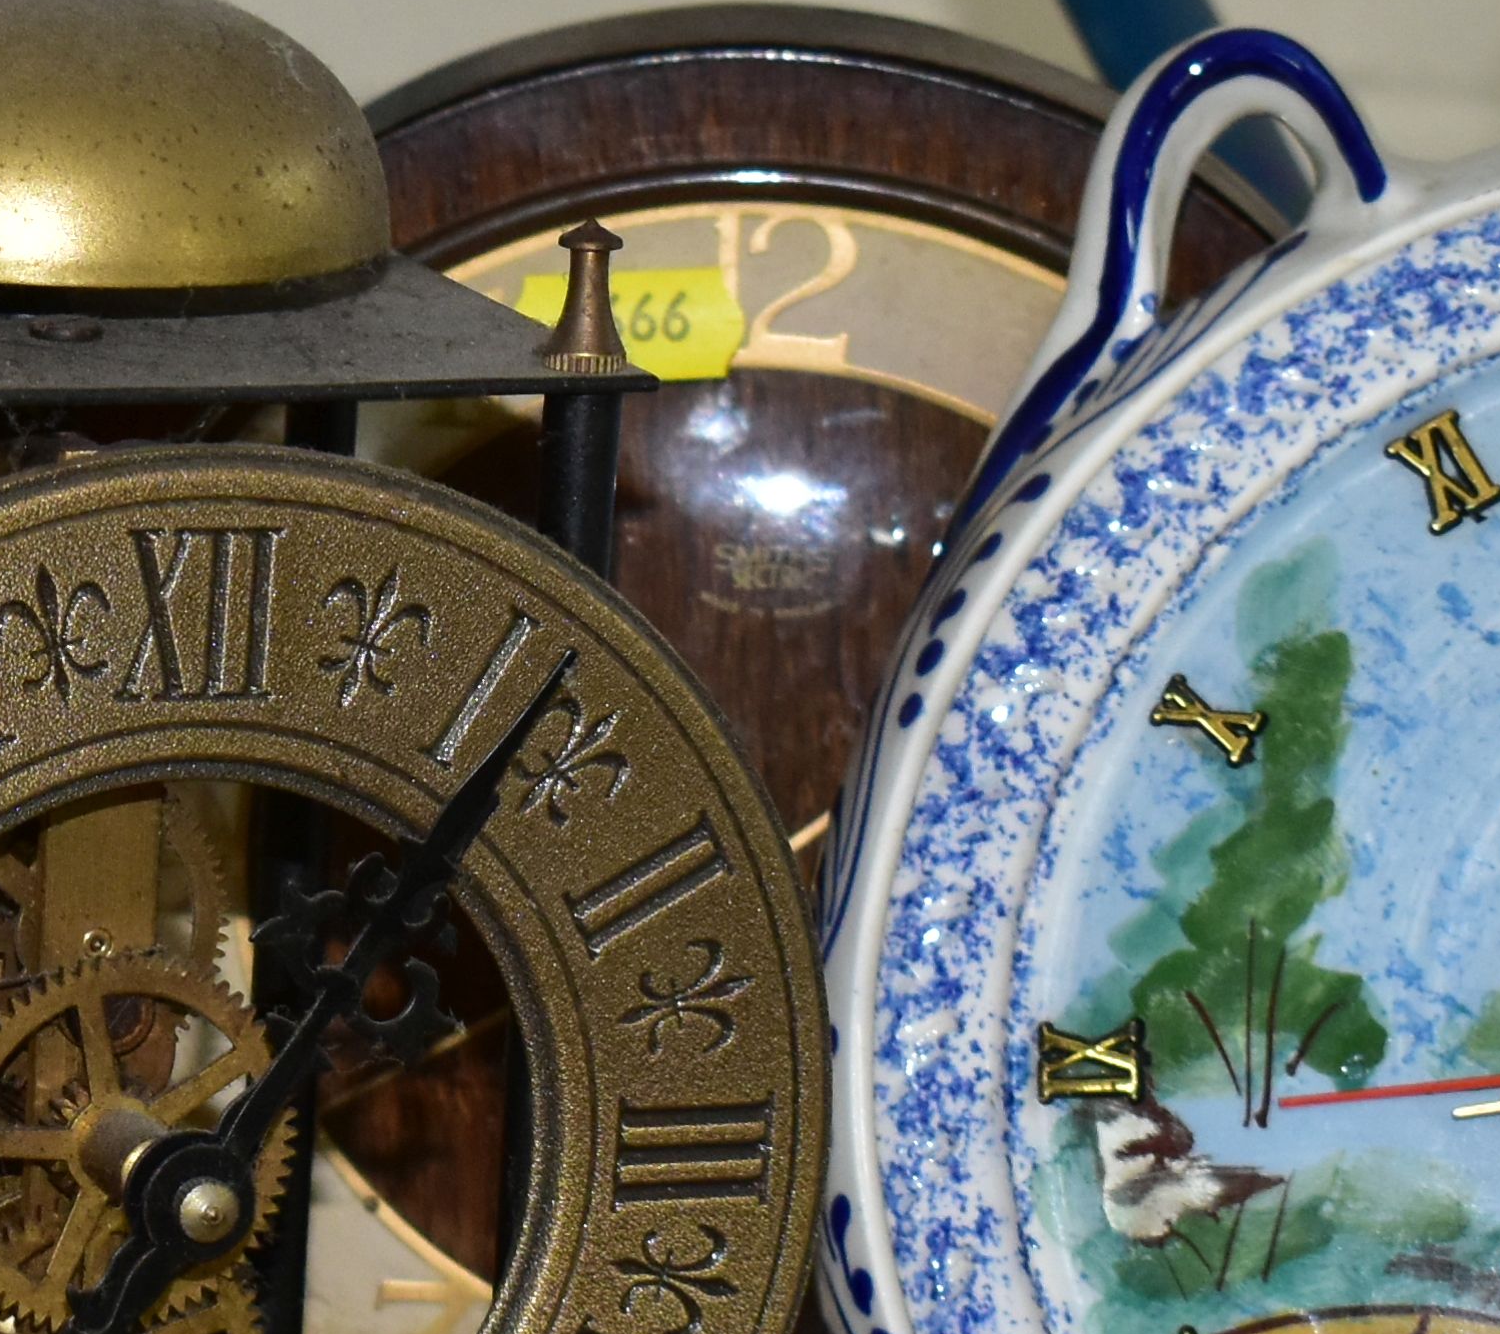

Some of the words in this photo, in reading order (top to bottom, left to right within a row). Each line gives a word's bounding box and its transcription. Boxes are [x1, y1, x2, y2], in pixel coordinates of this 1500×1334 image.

[611, 291, 691, 343] 66
[714, 212, 860, 365] 12
[114, 527, 286, 702] XII
[418, 607, 540, 770] I
[1150, 674, 1269, 767] X
[560, 809, 735, 961] II
[1037, 1017, 1148, 1105] IX
[614, 1089, 776, 1213] III
